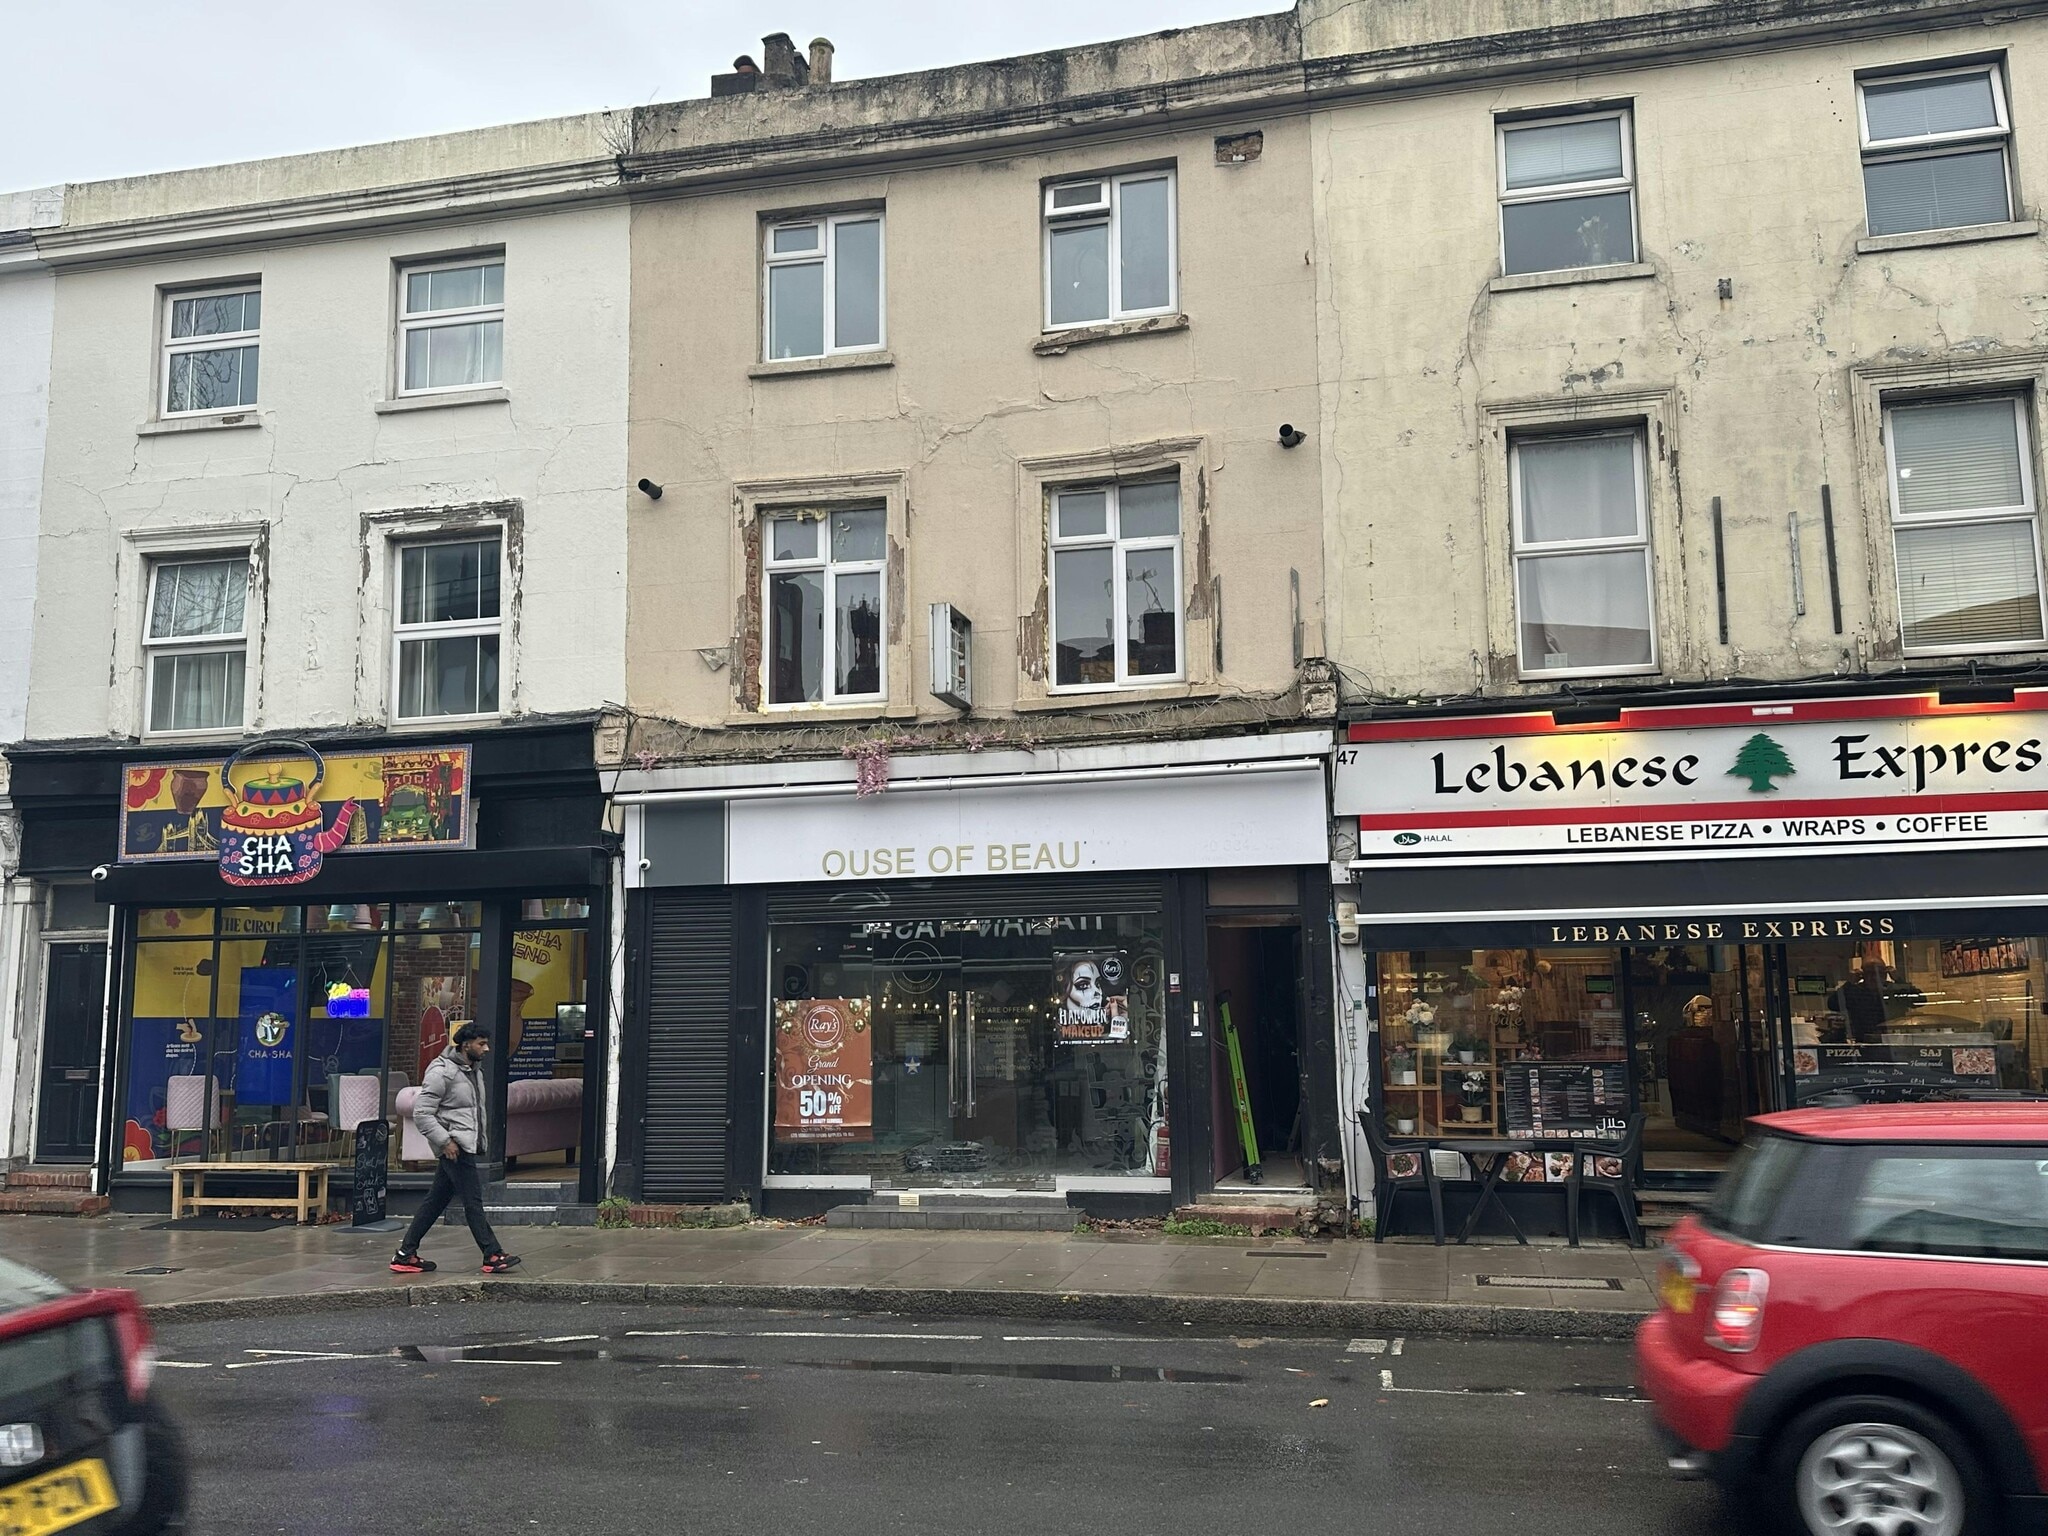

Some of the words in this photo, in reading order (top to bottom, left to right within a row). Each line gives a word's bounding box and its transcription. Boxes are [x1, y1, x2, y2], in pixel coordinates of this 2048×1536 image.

[1336, 750, 1359, 765] 47
[1430, 744, 1700, 794] Lebanese
[1831, 733, 2048, 794] Expres
[1567, 824, 1684, 844] LEBANESE
[1691, 822, 1754, 842] PIZZA
[1782, 818, 1866, 838] WRAPS
[1895, 814, 1989, 834] COFFEE
[241, 835, 292, 856] CHA
[1424, 834, 1453, 843] HALAL
[239, 854, 294, 875] SHA
[822, 847, 916, 877] OUSE
[928, 845, 975, 873] OF
[987, 840, 1081, 871] BEAU
[1551, 922, 1724, 943] LEBANESE
[1743, 917, 1895, 939] EXPRESS
[79, 943, 89, 953] 43
[328, 998, 370, 1018] OPEN
[1002, 1005, 1038, 1013] OFFERIG
[810, 1018, 838, 1034] Ray's
[1061, 1025, 1105, 1038] MAKEUP
[1825, 1049, 1862, 1057] PIZZA
[1919, 1049, 1943, 1057] SAJ
[807, 1055, 839, 1073] Grand
[792, 1074, 852, 1087] OPENING
[829, 1105, 841, 1115] OFF
[1595, 1117, 1626, 1131] حلال
